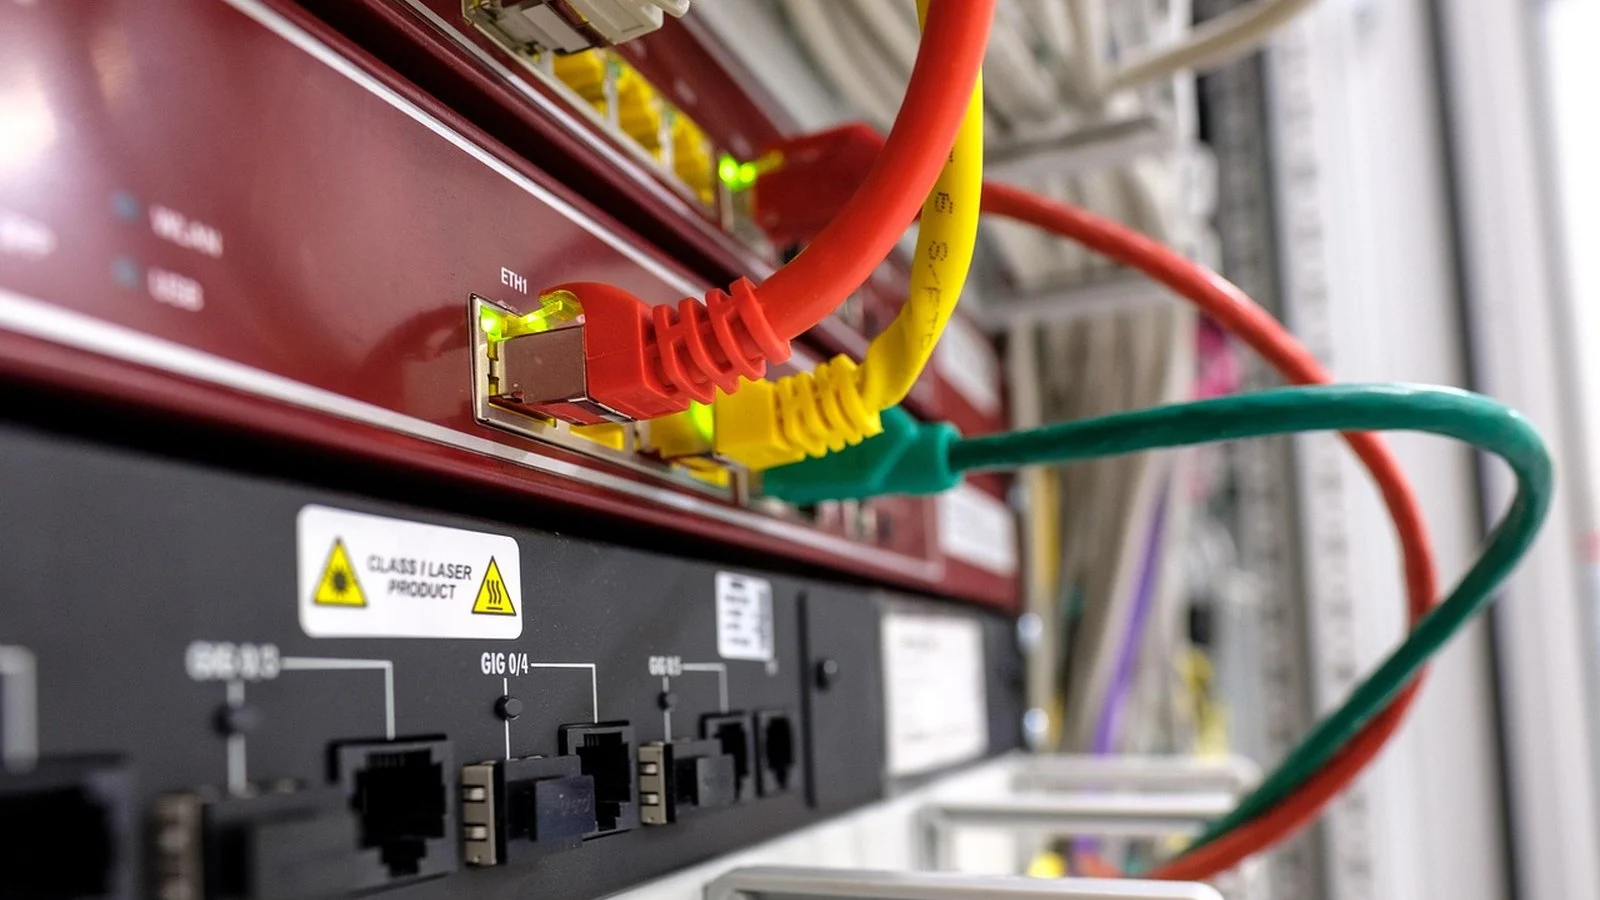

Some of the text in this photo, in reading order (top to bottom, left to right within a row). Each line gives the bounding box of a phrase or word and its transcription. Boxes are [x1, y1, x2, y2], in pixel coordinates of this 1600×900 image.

[501, 267, 527, 295] ETH1
[367, 554, 417, 576] CLASS
[428, 562, 472, 581] LASER
[387, 578, 456, 600] PRODUCT
[481, 652, 529, 677] GIG 0/4
